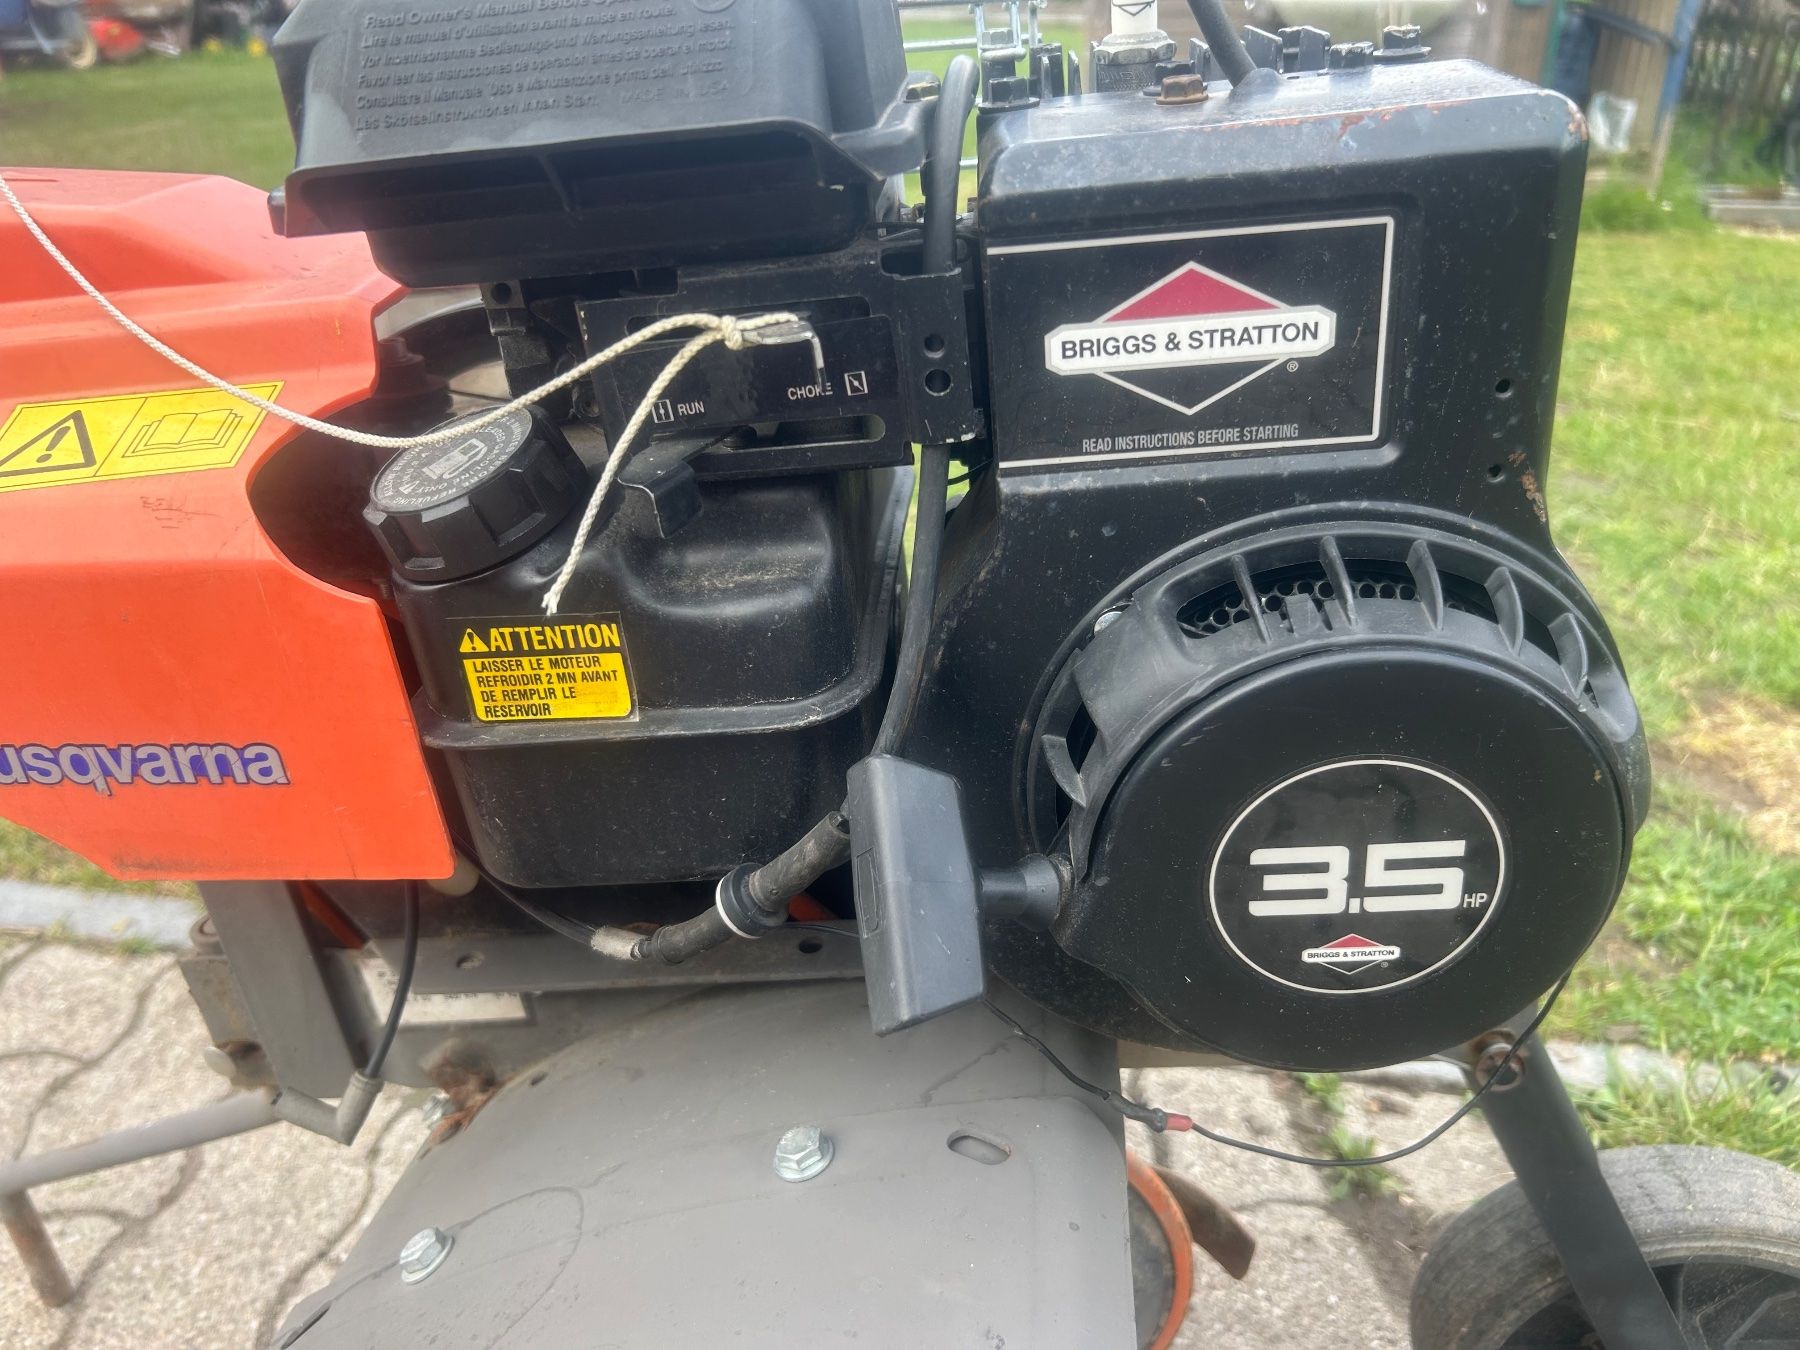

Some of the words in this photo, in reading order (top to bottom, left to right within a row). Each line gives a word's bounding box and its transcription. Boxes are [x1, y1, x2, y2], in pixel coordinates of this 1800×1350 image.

[360, 34, 386, 48] Lire
[390, 33, 401, 45] le
[454, 22, 528, 40] d'utilisation
[531, 15, 566, 33] avant
[570, 15, 580, 28] la
[584, 13, 616, 26] mise
[619, 11, 635, 22] en
[638, 5, 677, 20] route.
[365, 12, 404, 29] Read
[408, 7, 472, 25] Owner's
[476, 1, 533, 18] Manual
[360, 55, 381, 69] Vor
[582, 23, 695, 46] Wartungsanleitung
[358, 74, 390, 89] Favor
[392, 73, 414, 86] leer
[416, 71, 433, 83] las
[436, 63, 512, 82] instrucciones
[591, 52, 622, 65] antes
[625, 50, 640, 61] de
[357, 92, 421, 109] Consultare
[434, 86, 483, 103] Manuale
[517, 83, 523, 92] e
[526, 74, 610, 92] Manutenzione
[615, 70, 648, 86] prima
[620, 88, 665, 104] MADE
[1061, 333, 1156, 360] BRIGGS
[1165, 332, 1181, 351] &
[1188, 321, 1320, 350] STRATTON
[677, 401, 705, 416] RUN
[1082, 437, 1112, 453] READ
[1115, 431, 1195, 451] INSTRUCTIONS
[1197, 428, 1241, 445] BEFORE
[1243, 423, 1300, 442] STARTING
[390, 486, 457, 506] REFUELING
[490, 623, 621, 652] ATTENTION
[473, 659, 525, 673] LAISSER
[528, 657, 544, 671] LE
[550, 655, 602, 670] MOTEUR
[476, 673, 543, 688] REFROIDIR
[546, 673, 554, 685] 2
[557, 671, 577, 684] MN
[581, 670, 618, 683] AVANT
[481, 690, 497, 703] DE
[503, 687, 557, 702] REMPLIR
[562, 686, 577, 699] LE
[484, 703, 552, 719] RESERVOIR
[1248, 839, 1466, 917] 3.5
[1462, 892, 1488, 908] HP
[1307, 950, 1340, 959] BRIGGS
[1342, 951, 1349, 959] &
[1350, 948, 1395, 958] STRATTON
